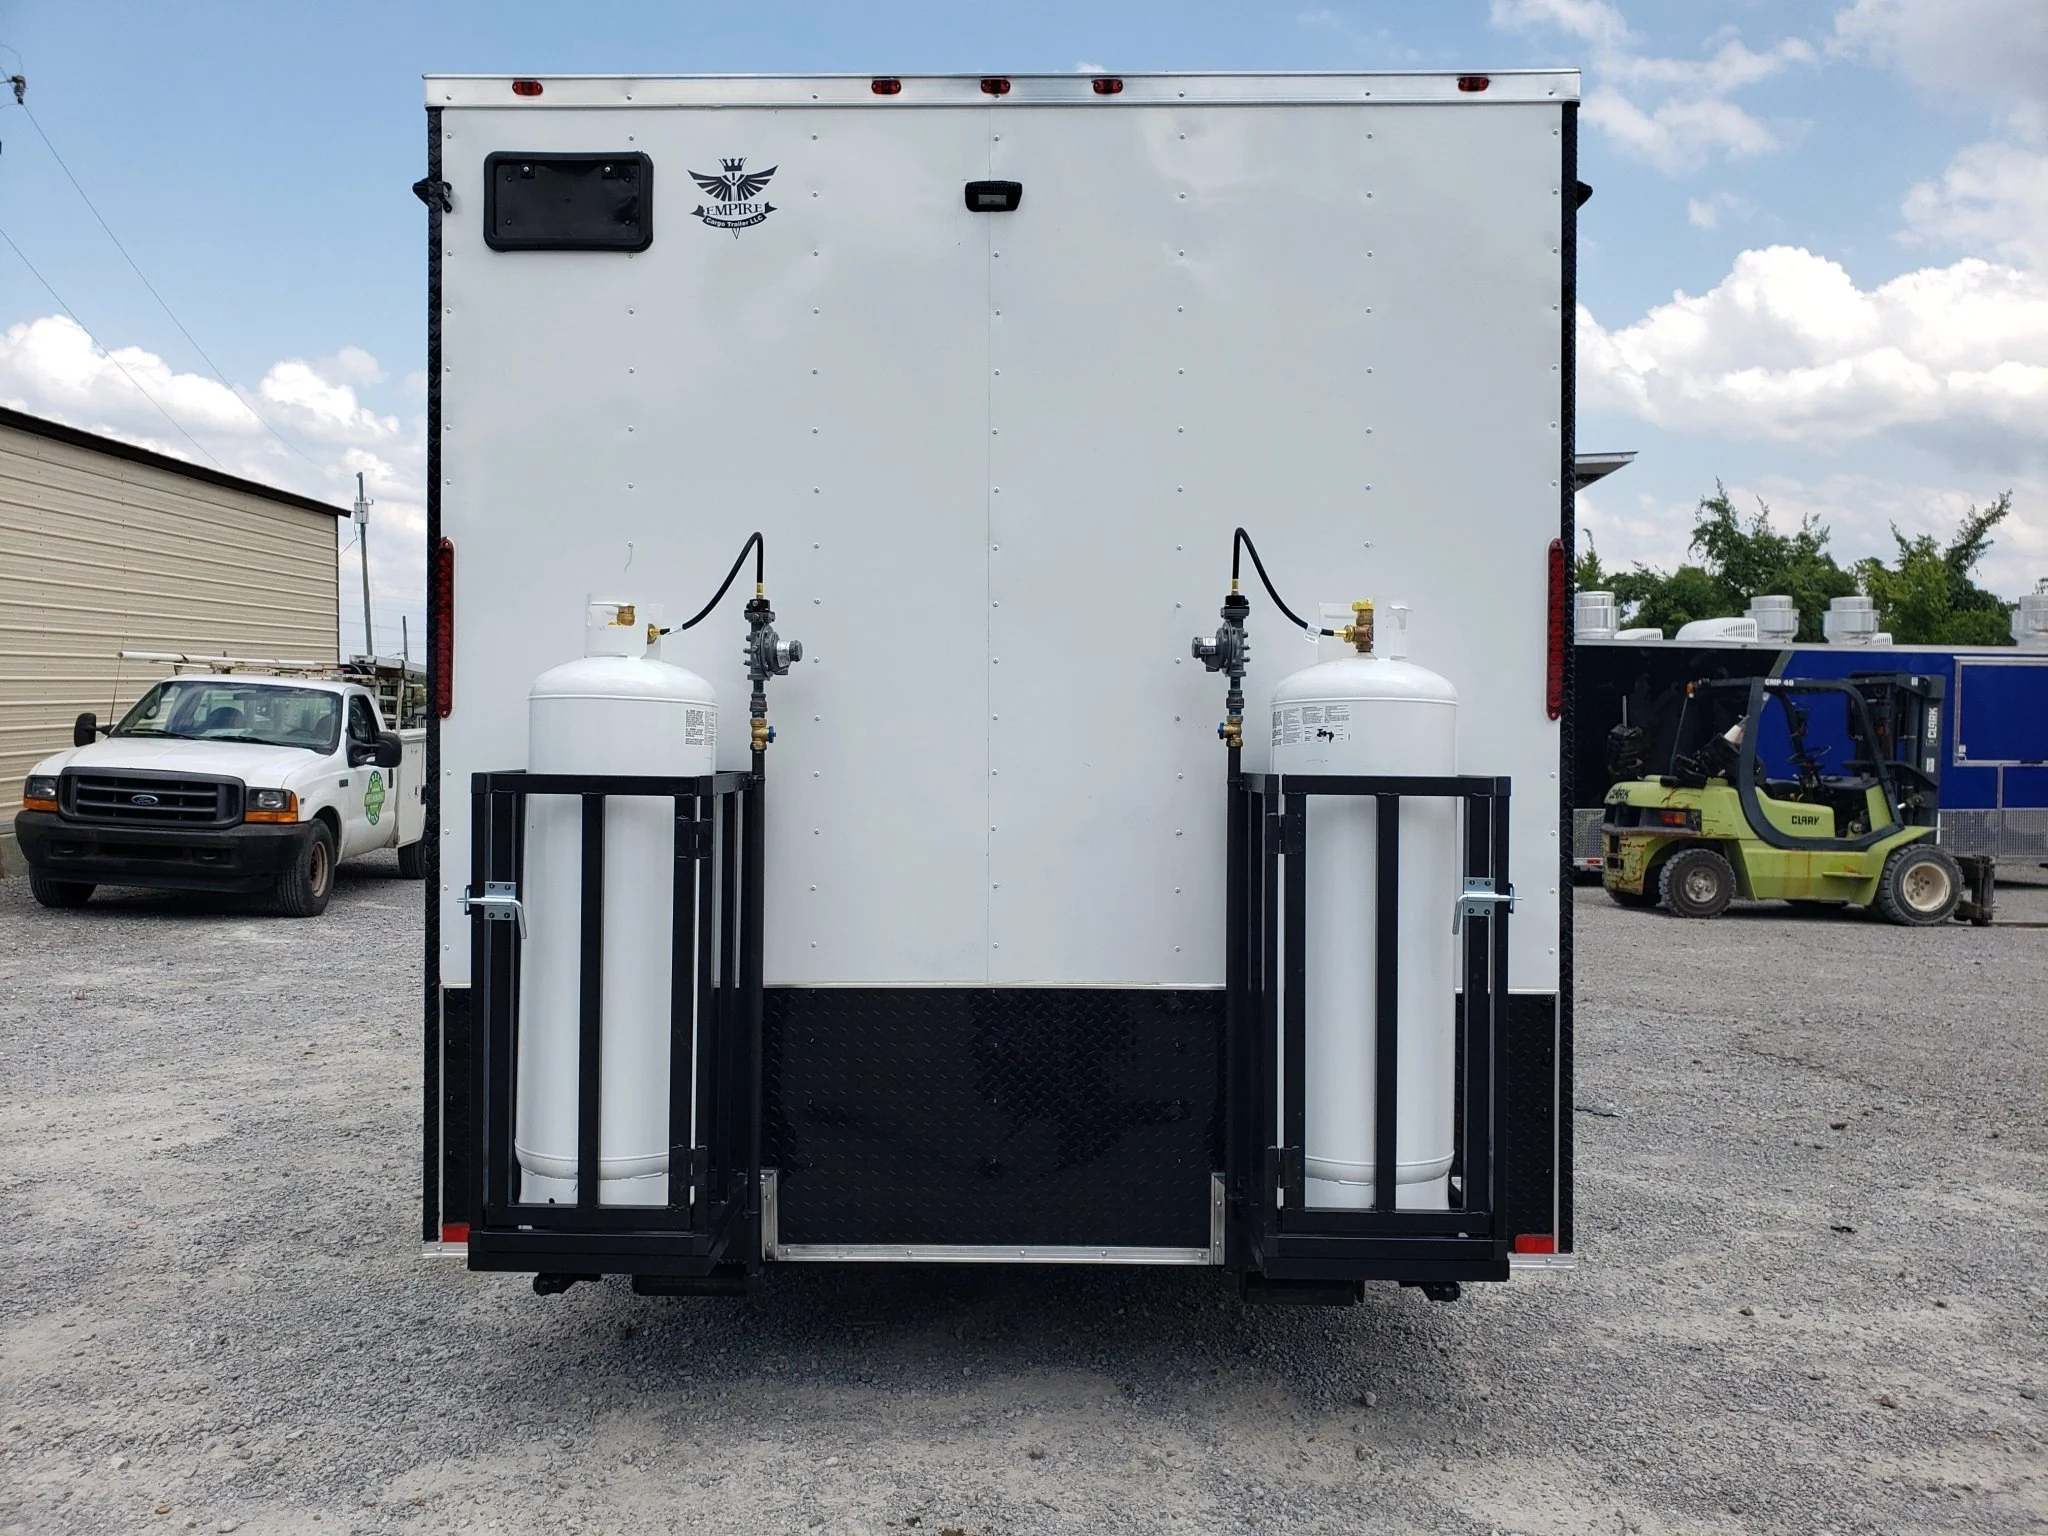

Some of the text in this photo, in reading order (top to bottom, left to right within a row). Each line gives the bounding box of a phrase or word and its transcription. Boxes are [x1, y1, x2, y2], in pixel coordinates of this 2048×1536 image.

[706, 203, 763, 215] EMPIRE
[706, 217, 725, 226] Cargo
[750, 215, 763, 223] LLC
[1928, 707, 1938, 738] CLARK
[1791, 815, 1820, 825] CLARK
